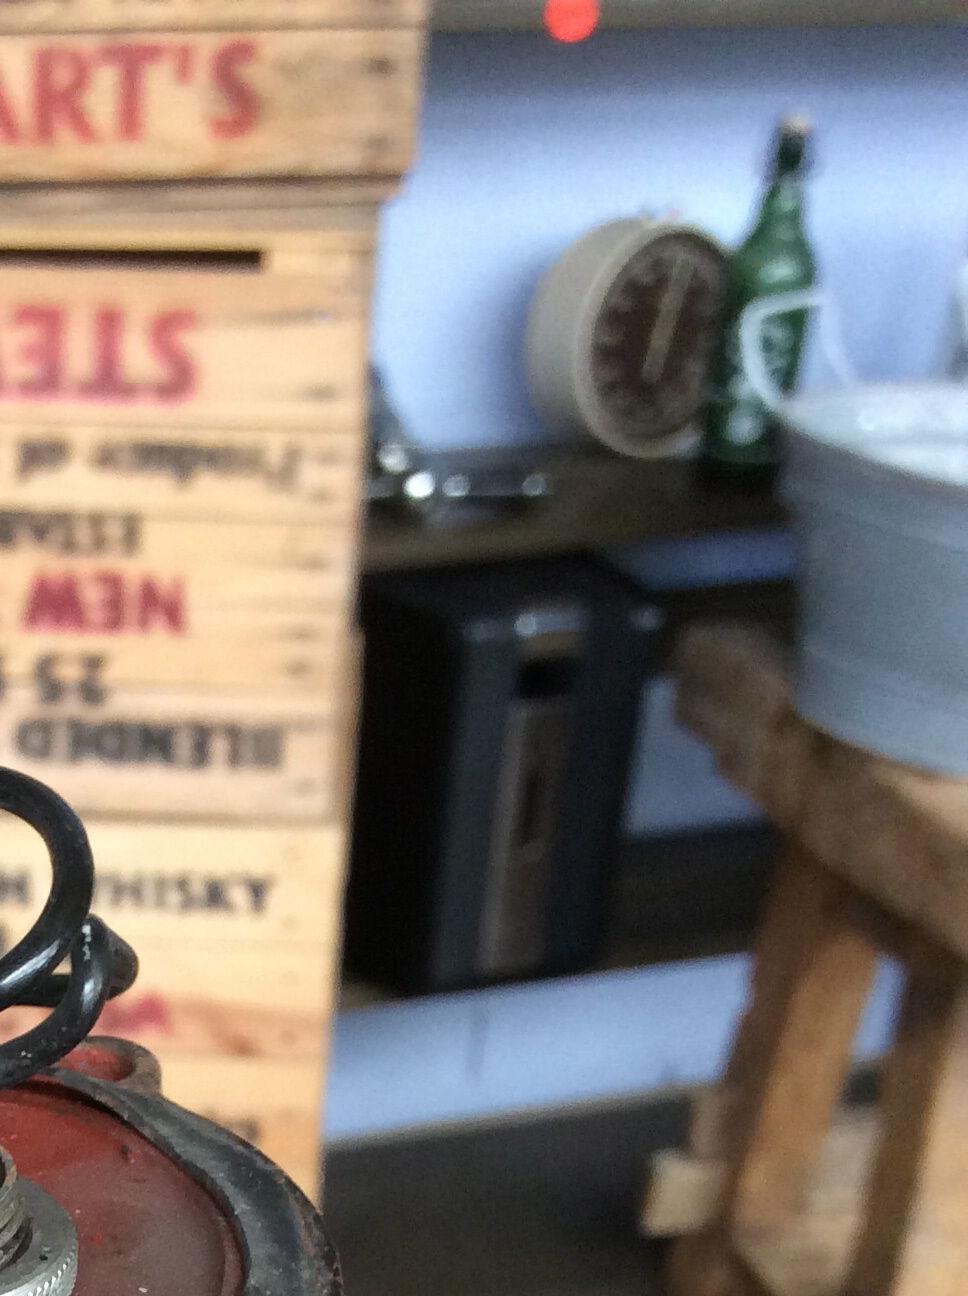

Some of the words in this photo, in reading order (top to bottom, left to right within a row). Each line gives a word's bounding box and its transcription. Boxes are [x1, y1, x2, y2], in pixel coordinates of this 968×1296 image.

[17, 438, 71, 484] of
[20, 569, 189, 637] NEW
[33, 650, 109, 704] 25
[16, 714, 284, 769] BLENDED
[92, 870, 273, 914] HISKY
